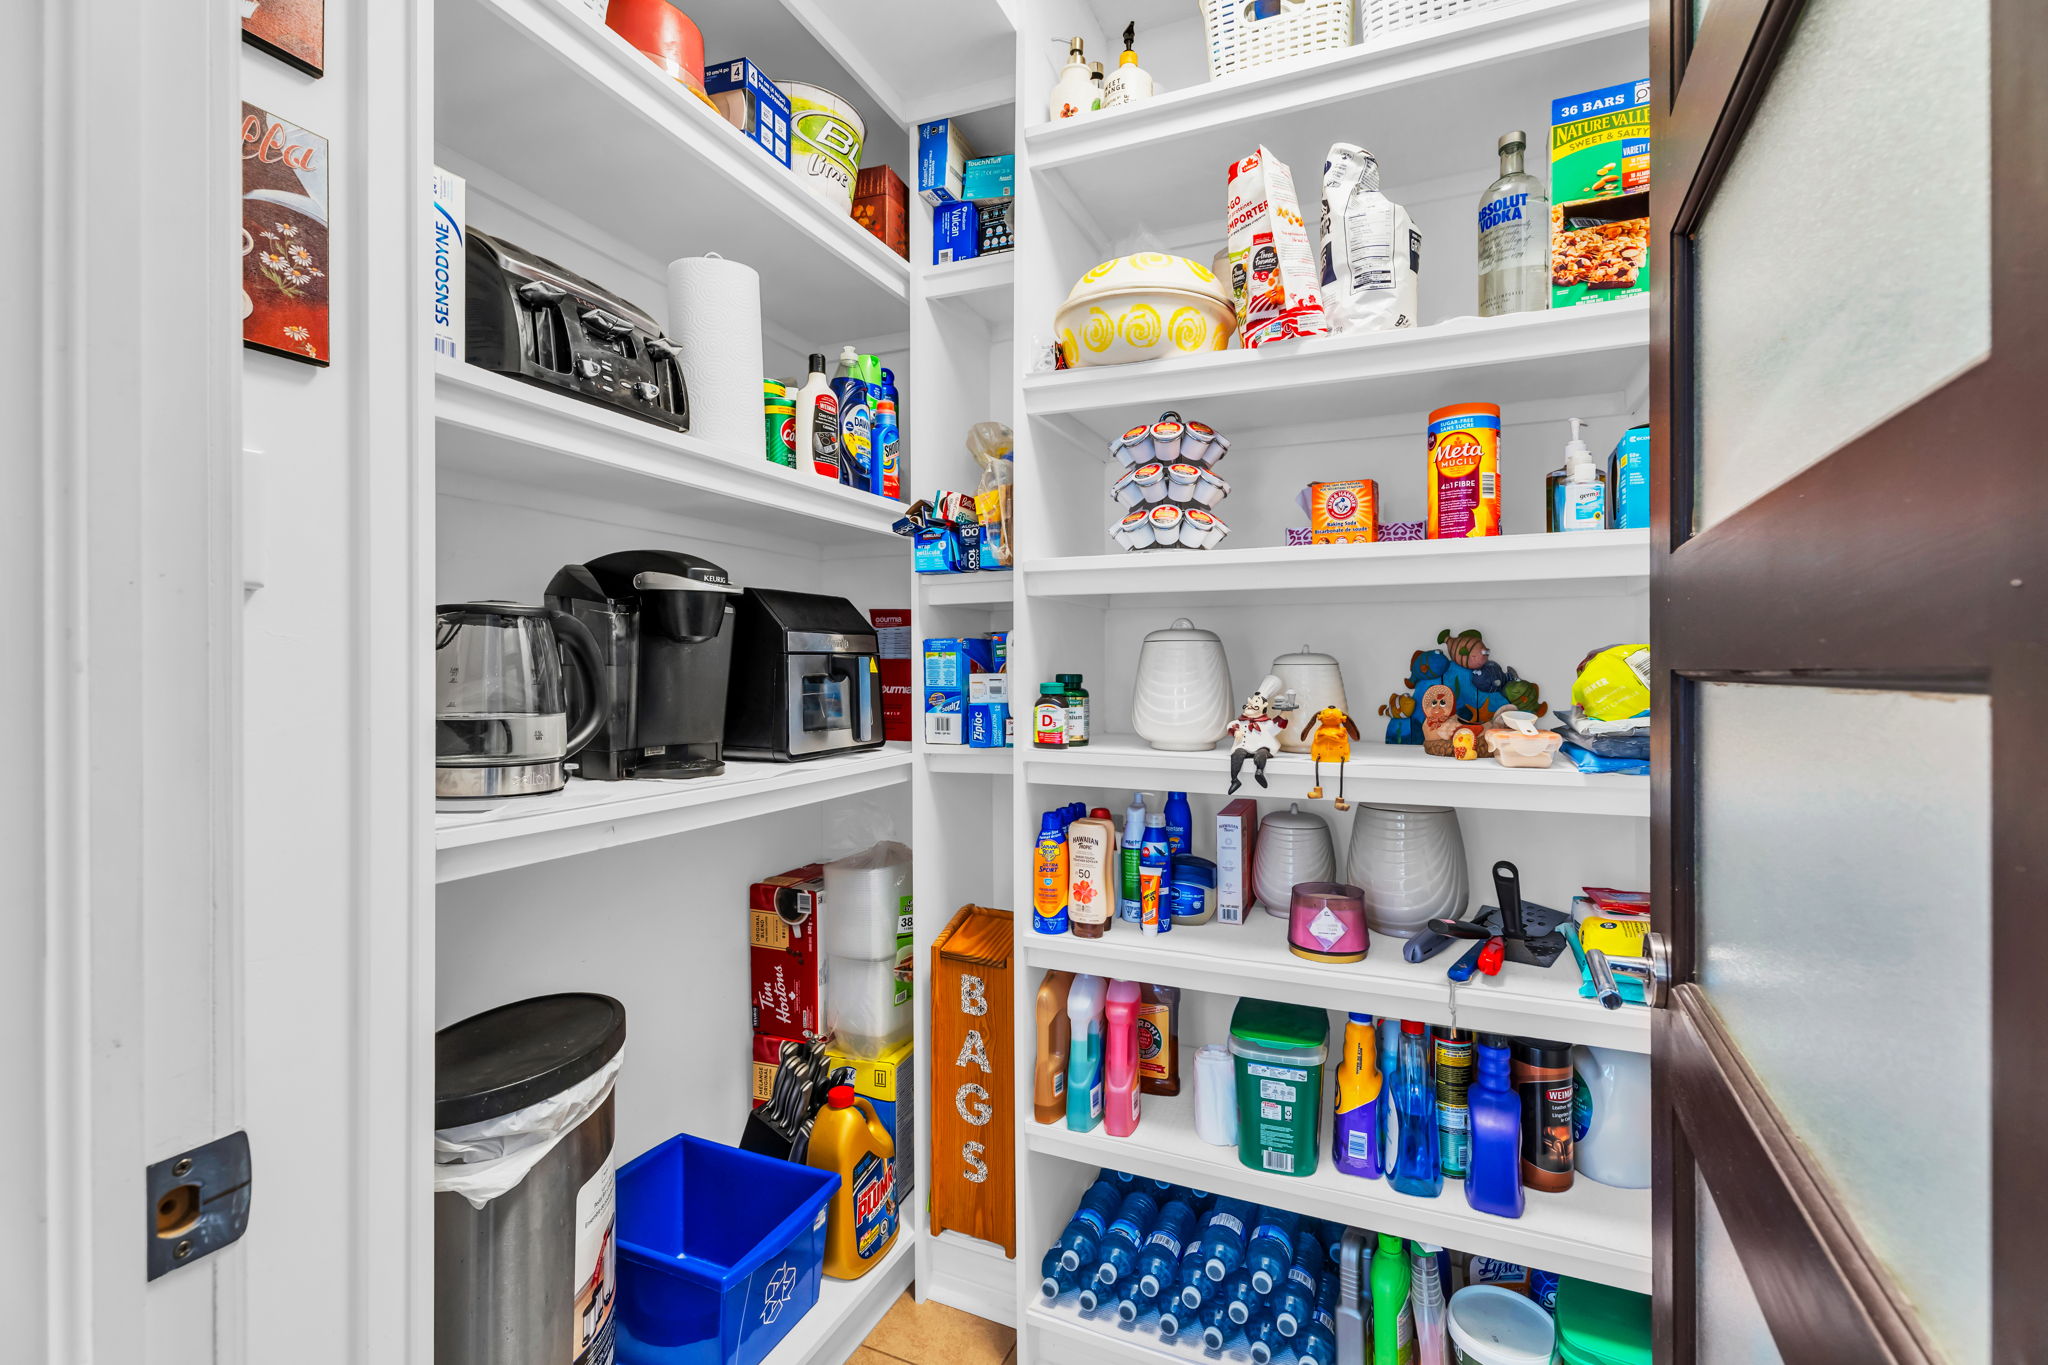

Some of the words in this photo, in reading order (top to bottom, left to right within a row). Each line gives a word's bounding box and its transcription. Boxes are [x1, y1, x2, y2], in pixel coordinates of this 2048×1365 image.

[734, 66, 741, 77] 4
[750, 71, 756, 81] 4
[1561, 105, 1578, 117] 36
[1582, 94, 1625, 112] BARS
[1556, 115, 1611, 147] NATURE
[1569, 134, 1603, 151] SWEET
[1606, 132, 1614, 140] &
[1617, 127, 1649, 139] SALTY
[1623, 144, 1647, 157] VARIETY
[807, 152, 849, 189] Lime
[968, 157, 1002, 167] TouchNTuff
[1479, 193, 1528, 223] ABSOLUT
[951, 208, 961, 237] Vulcan
[1480, 207, 1522, 233] VODKA
[435, 221, 449, 326] SENSODYNE
[1440, 418, 1474, 427] SUGAR-FREE
[1440, 424, 1454, 432] SANS
[1455, 422, 1474, 430] SUCRE
[1434, 442, 1485, 463] Meta
[1441, 458, 1475, 467] MUCIL
[703, 574, 726, 584] KEURIG
[940, 701, 961, 713] Ziploc
[973, 712, 984, 741] Ziploc
[1073, 836, 1099, 846] HAWAIIAN
[1042, 848, 1055, 856] BOAT
[1039, 865, 1058, 873] SPORT
[1078, 868, 1091, 879] 50
[759, 981, 775, 1010] Tim
[774, 964, 792, 1024] Hortons
[1137, 1018, 1161, 1042] RPHY
[955, 973, 993, 1184] BAGS
